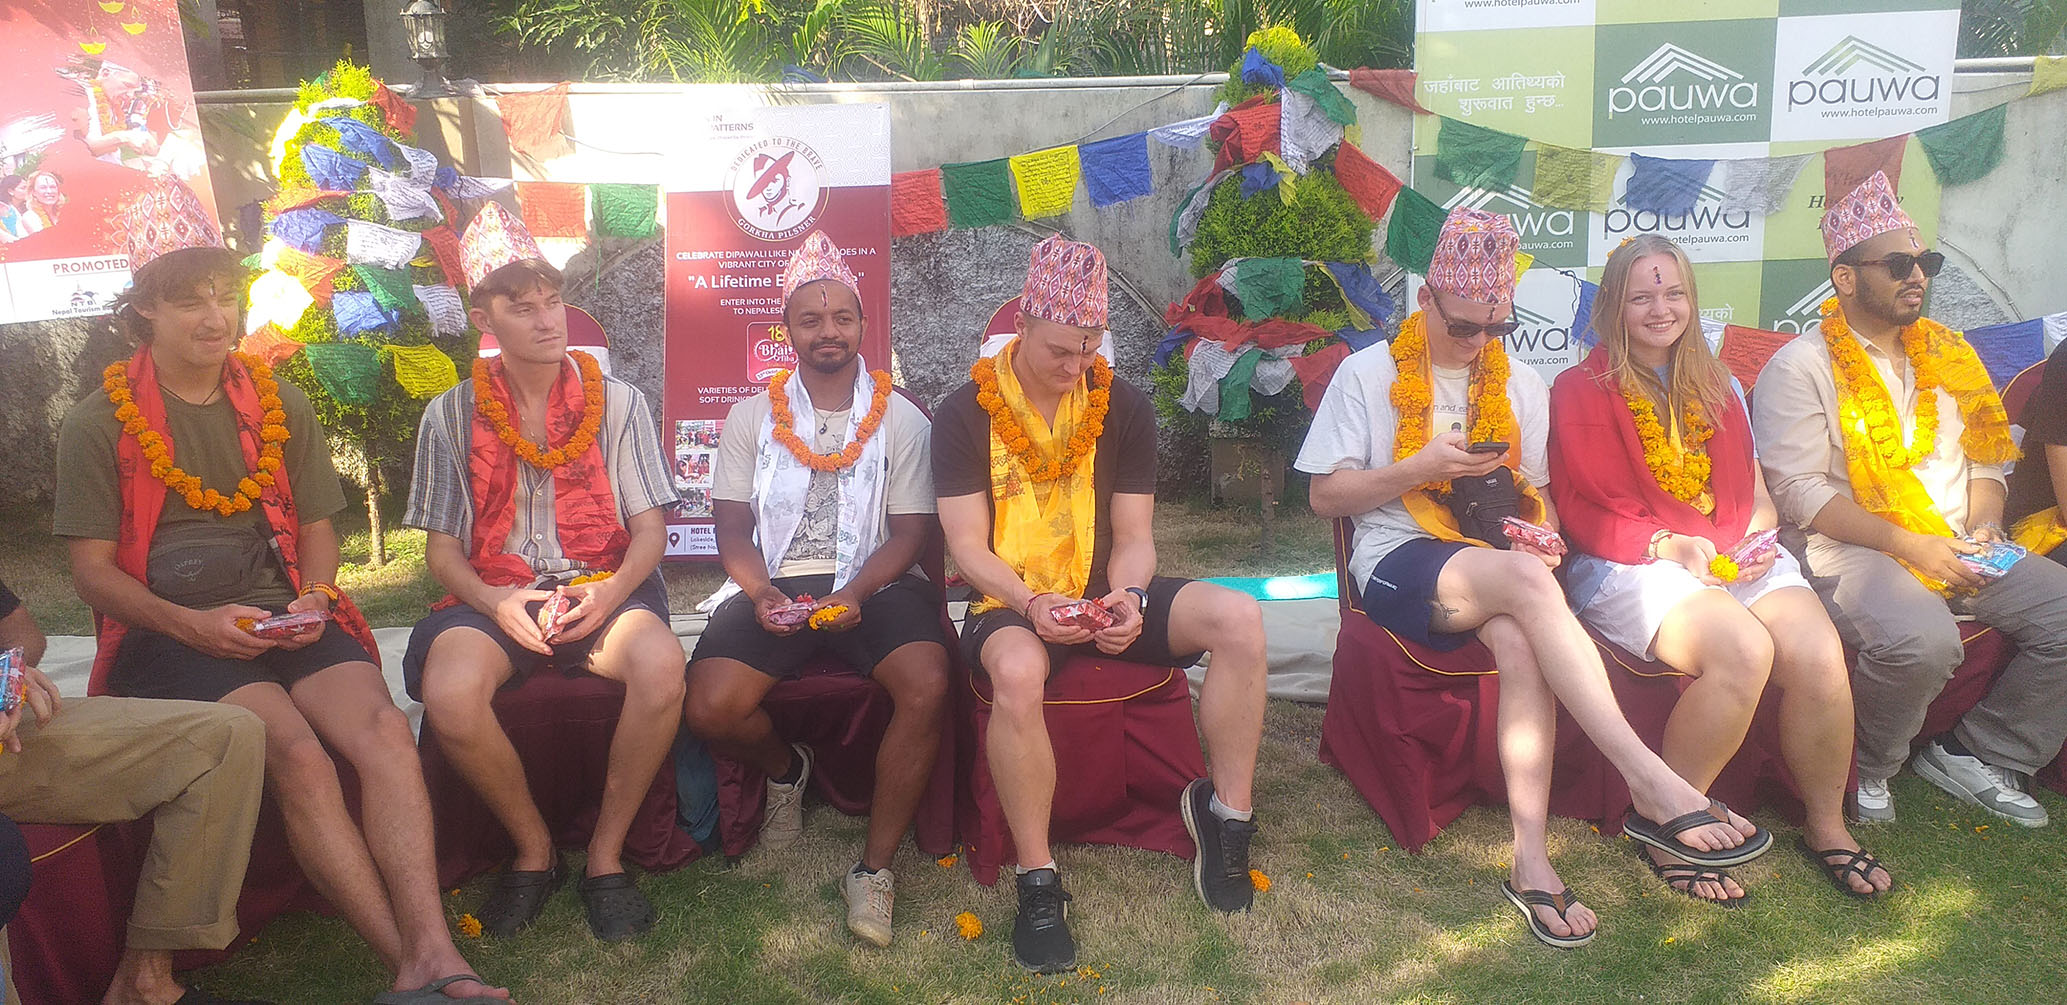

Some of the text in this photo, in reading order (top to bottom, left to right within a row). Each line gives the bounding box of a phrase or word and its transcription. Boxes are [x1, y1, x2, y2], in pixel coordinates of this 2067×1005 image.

[1787, 74, 1941, 112] pauwa
[1608, 82, 1758, 120] pauwa
[1821, 105, 1938, 119] www.hotelpauwa.com
[1641, 113, 1757, 125] www.hotelpauwa.com
[730, 138, 823, 172] DEDICATED TO THE BRAVE
[737, 215, 816, 239] GORKHA PILSNER
[676, 251, 724, 260] CELEBRATE
[726, 250, 767, 259] DIPAWALI
[769, 249, 787, 258] LIKE
[858, 247, 868, 255] IN
[869, 247, 877, 255] A
[53, 259, 129, 274] PROMOTED
[718, 260, 756, 269] VIBRANT
[757, 260, 776, 268] CITY
[711, 274, 772, 288] Lifetime
[720, 297, 782, 306] ENTER INTO THE
[52, 308, 73, 316] Nepal
[733, 307, 745, 315] TO
[697, 386, 738, 395] VARIETIES
[739, 386, 750, 394] OF
[699, 396, 719, 404] SOFT
[690, 527, 711, 535] HOTEL
